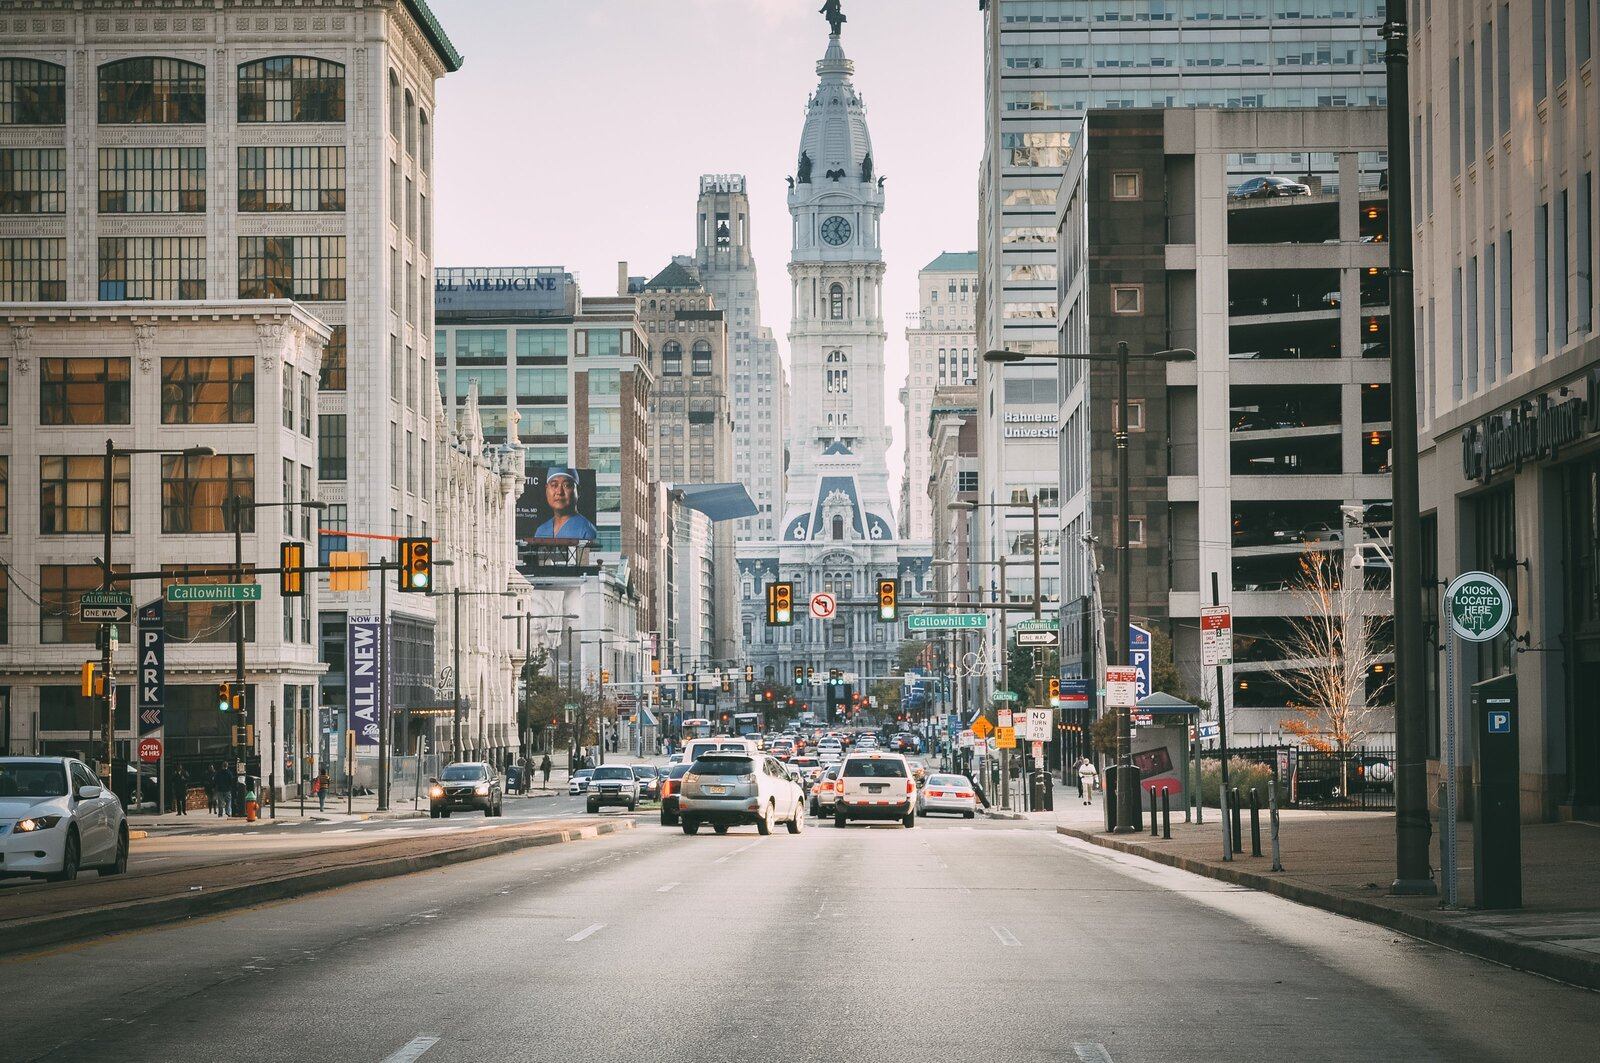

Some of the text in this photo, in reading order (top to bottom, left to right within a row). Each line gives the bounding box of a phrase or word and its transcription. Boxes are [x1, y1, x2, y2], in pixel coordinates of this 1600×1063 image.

[466, 277, 556, 291] MEDICINE
[1004, 426, 1058, 438] Universit
[174, 587, 256, 599] Callowhill St
[1462, 586, 1493, 595] KIOSK
[81, 595, 122, 603] CALLOWHILL
[1455, 596, 1501, 605] LOCATED
[85, 608, 117, 617] ONE WAY
[1464, 606, 1491, 615] HERE
[913, 617, 982, 626] Callowhill St
[143, 632, 159, 702] PARK
[354, 626, 374, 722] ALL NEW
[1494, 714, 1507, 729] P
